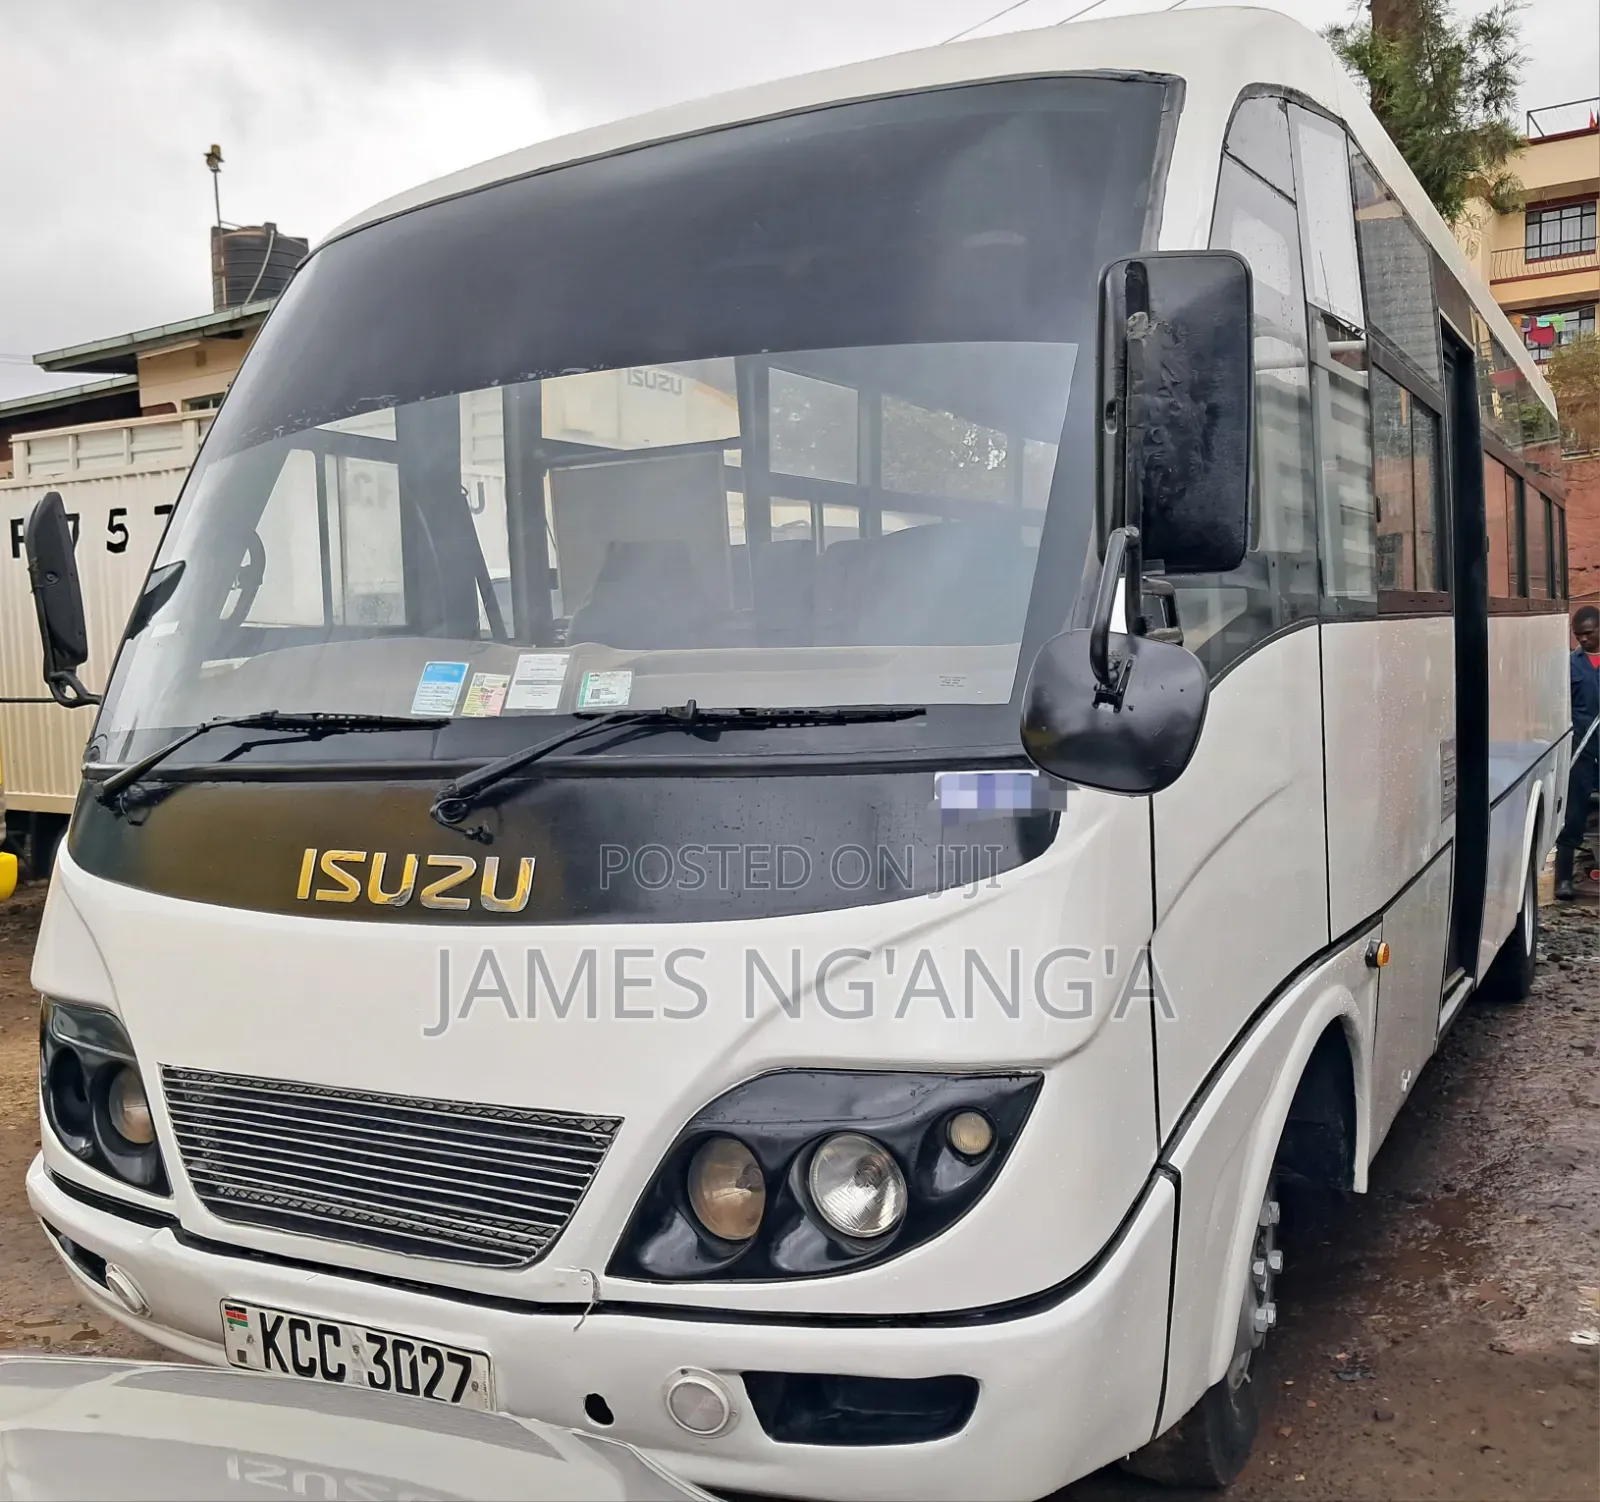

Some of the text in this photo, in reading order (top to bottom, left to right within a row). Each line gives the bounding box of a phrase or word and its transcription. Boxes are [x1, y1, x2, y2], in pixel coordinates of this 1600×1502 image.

[627, 368, 682, 395] ISUZU
[297, 848, 536, 913] ISUZU
[259, 1311, 347, 1384] KCC
[365, 1331, 472, 1405] 3027
